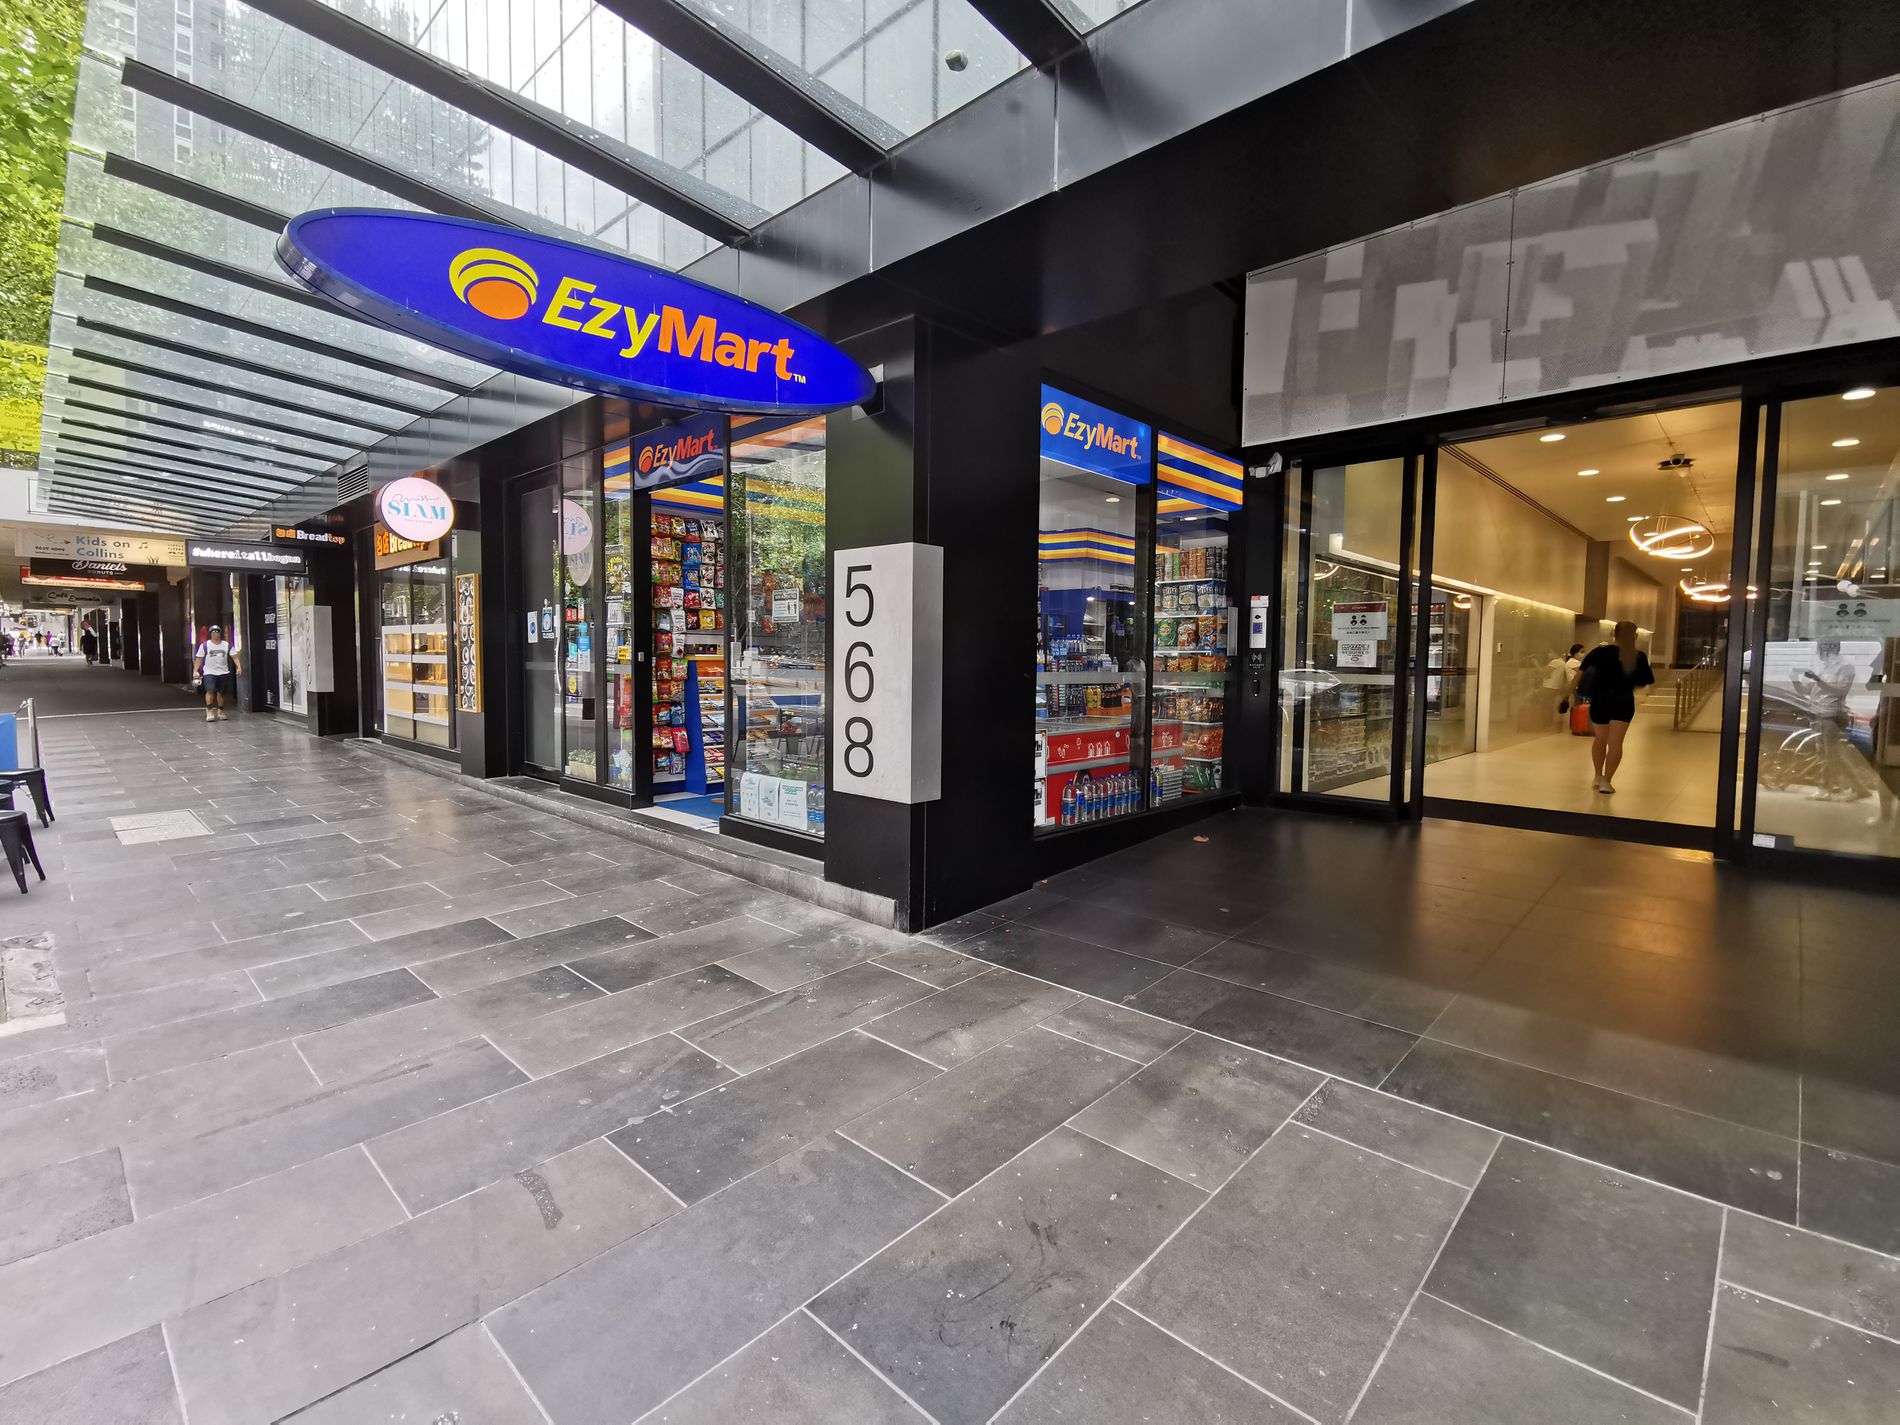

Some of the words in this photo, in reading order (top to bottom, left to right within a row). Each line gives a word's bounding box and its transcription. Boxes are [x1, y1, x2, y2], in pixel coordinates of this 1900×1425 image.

[542, 276, 795, 381] EzyMart
[1064, 412, 1139, 459] EzyMart
[653, 428, 715, 470] EzyMart
[387, 501, 447, 521] SIAM
[76, 535, 107, 547] Kids
[296, 529, 346, 544] Breadtop
[76, 547, 125, 560] Collins
[71, 559, 128, 572] Daniels
